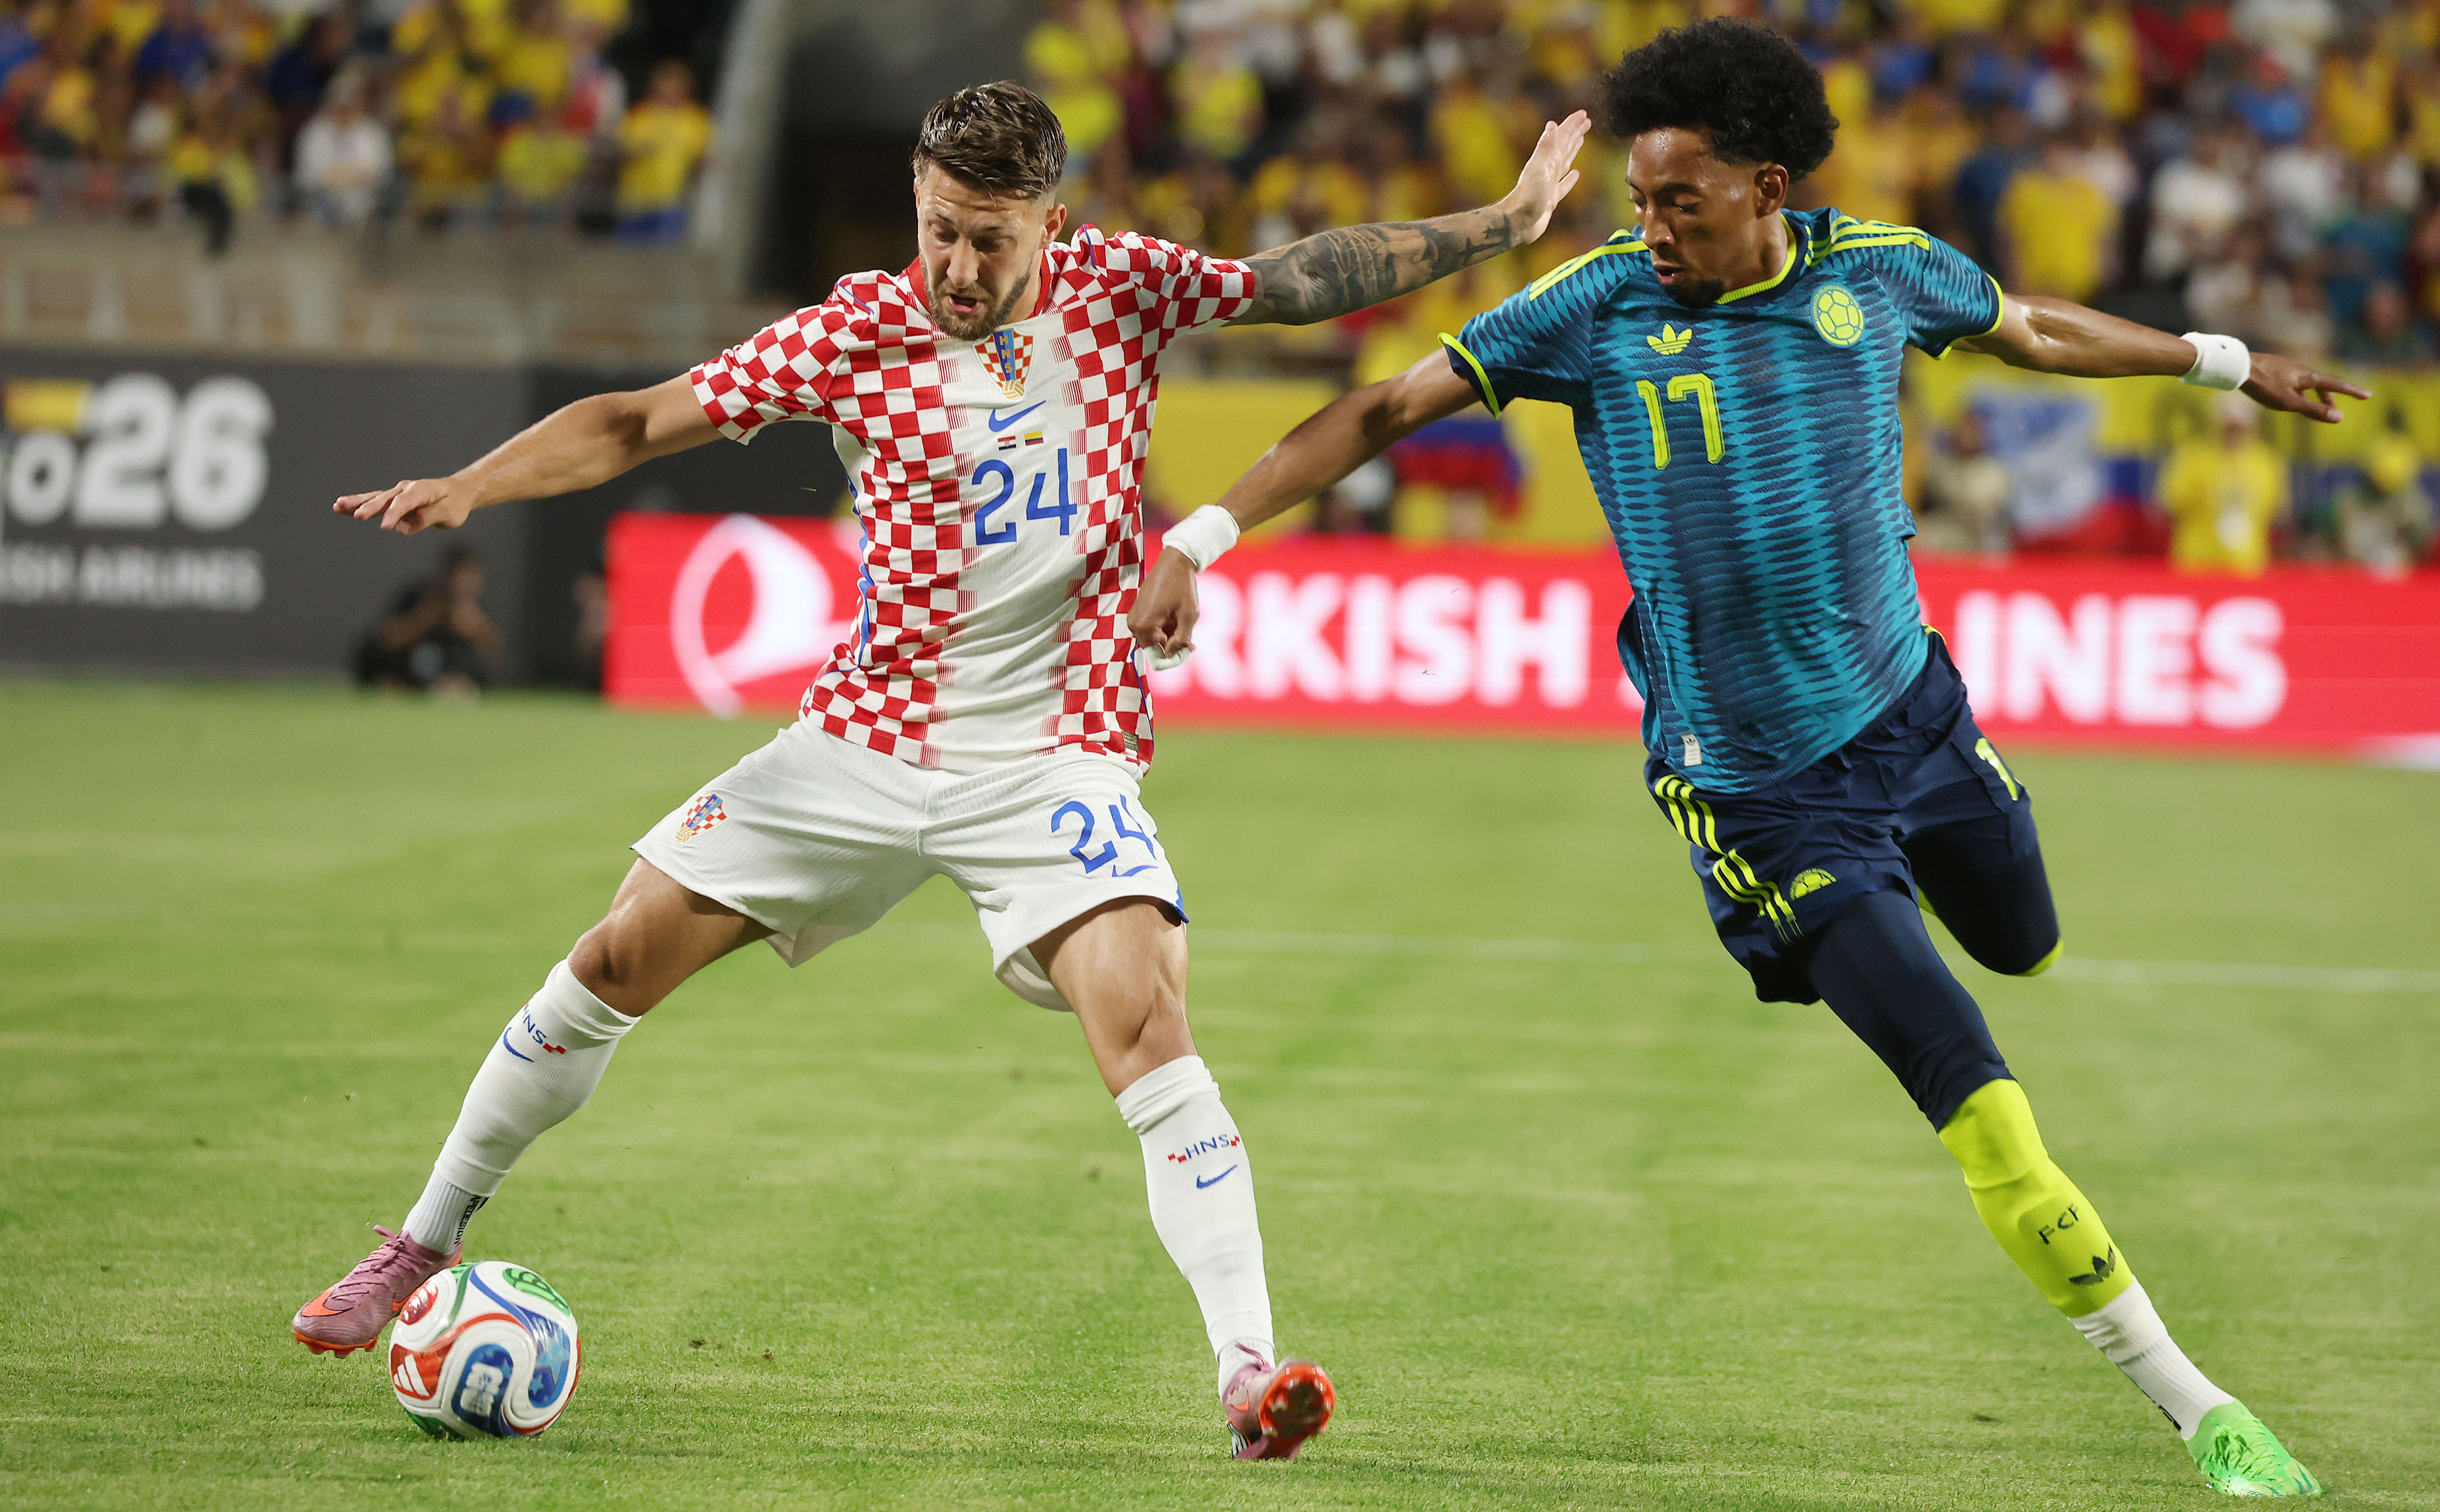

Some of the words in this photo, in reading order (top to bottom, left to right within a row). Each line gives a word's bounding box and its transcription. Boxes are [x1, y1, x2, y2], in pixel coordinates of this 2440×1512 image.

[1637, 373, 1724, 470] 17
[972, 448, 1078, 546] 24
[1147, 573, 1592, 708] RKISH
[1919, 589, 2287, 730] INES
[1974, 737, 2020, 801] 1
[1051, 793, 1157, 874] 24
[1185, 1134, 1230, 1159] HNS
[2038, 1203, 2079, 1244] FCF
